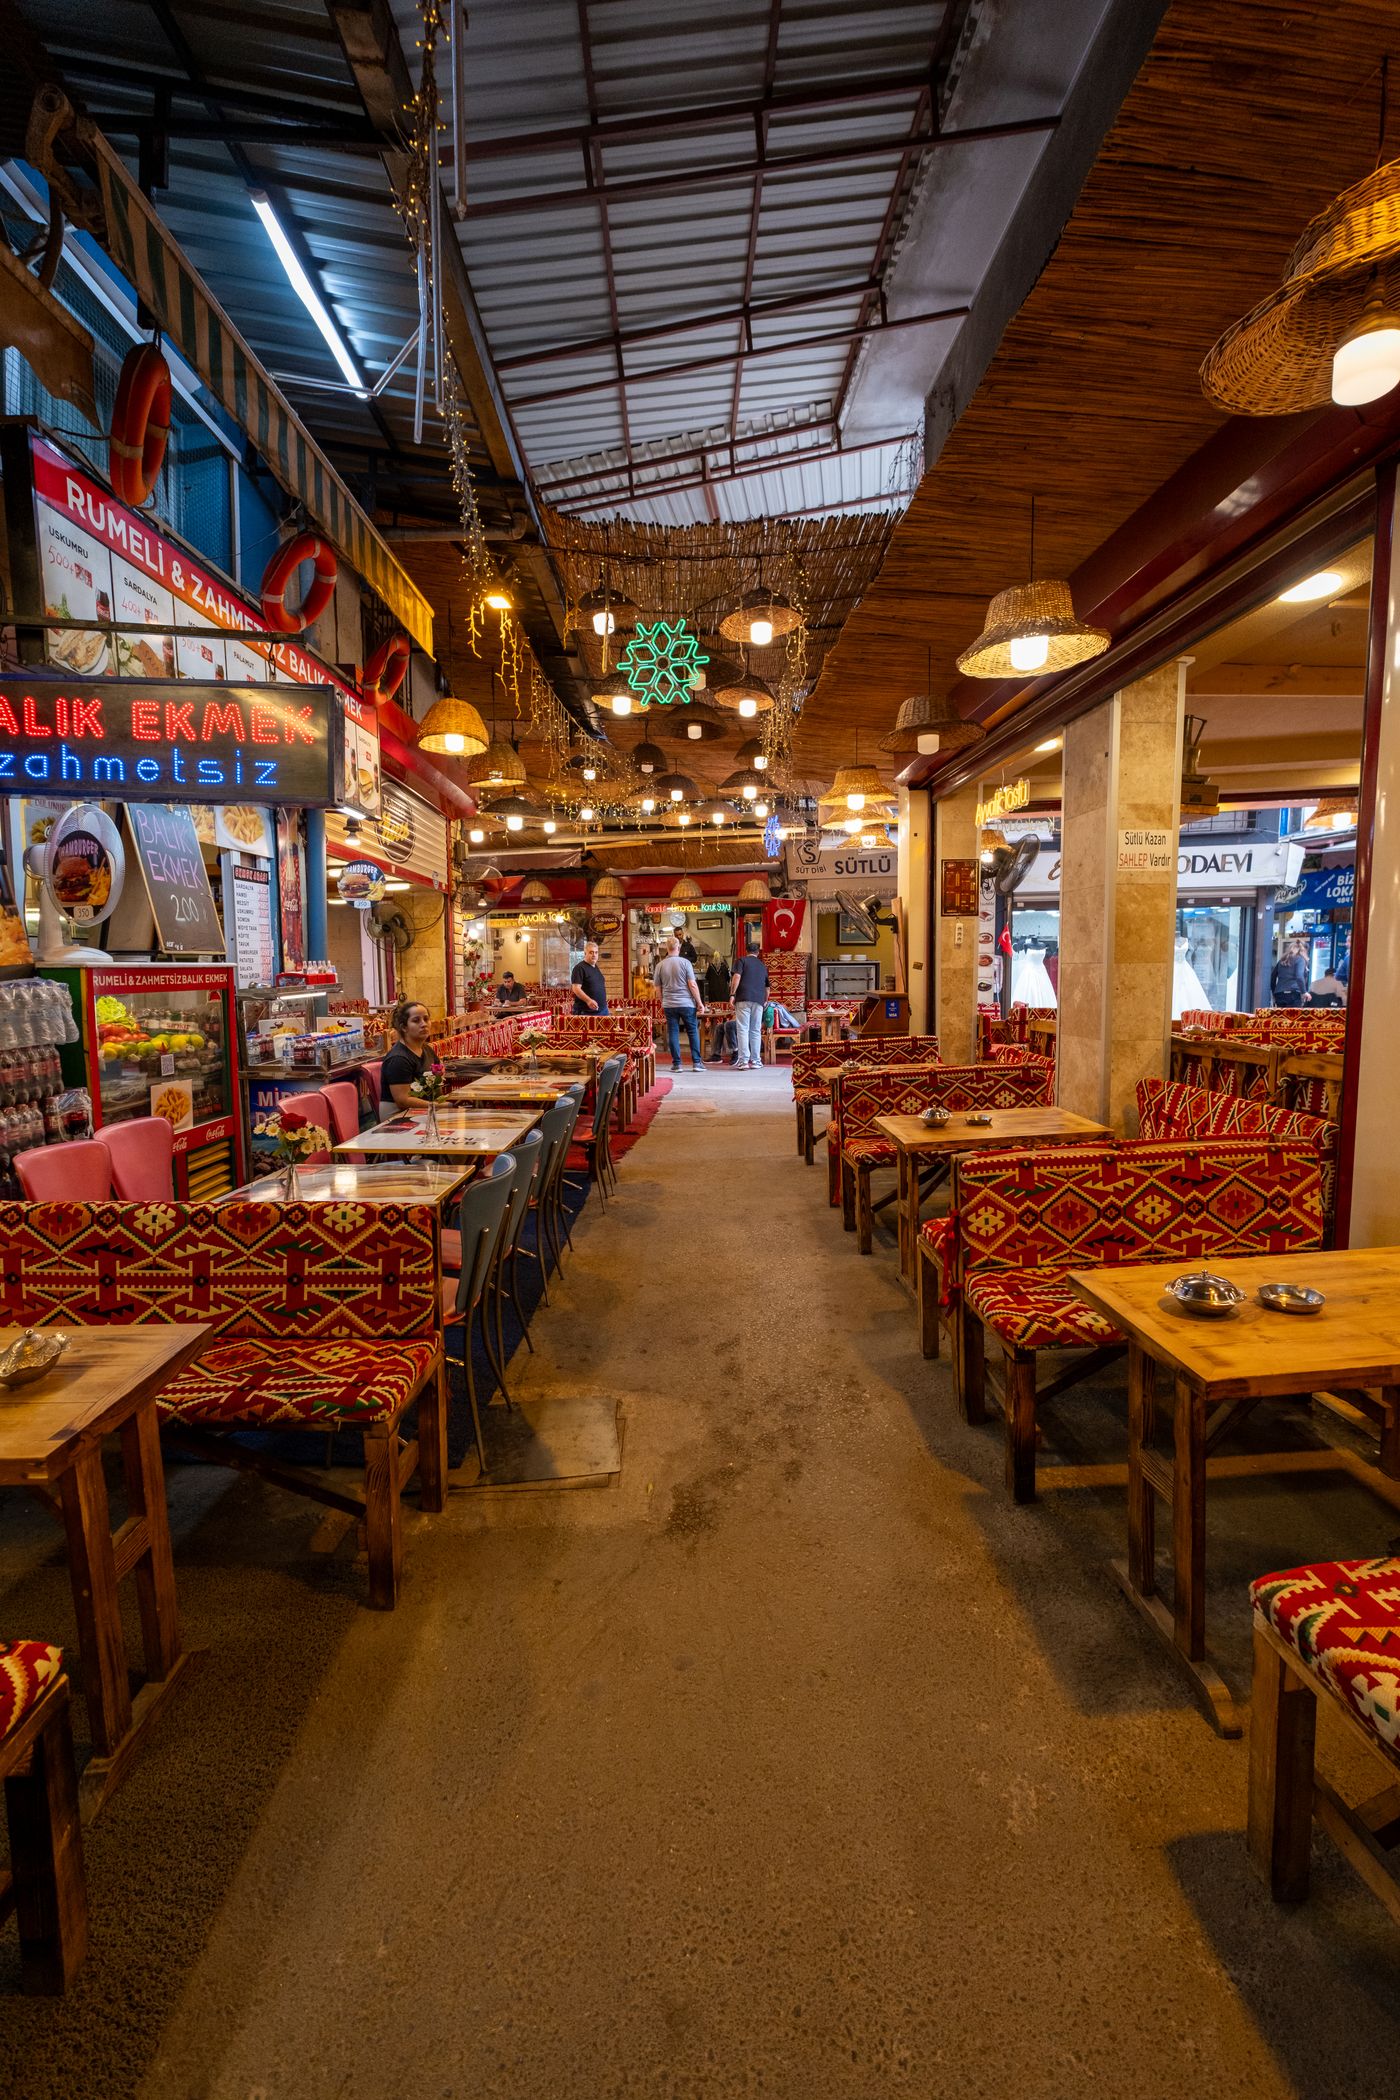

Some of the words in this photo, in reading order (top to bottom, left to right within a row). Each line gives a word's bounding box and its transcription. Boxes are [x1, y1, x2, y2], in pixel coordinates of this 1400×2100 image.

[48, 526, 89, 560] USKUMRU
[66, 476, 164, 577] RUMELİ
[171, 560, 186, 591] &
[123, 577, 158, 606] SARDALYA
[131, 699, 315, 745] EKMEK
[0, 742, 279, 786] zahmetsiz
[136, 808, 194, 855] BALIK
[1124, 831, 1143, 846] Sütlü
[1144, 833, 1167, 846] Kazan
[146, 850, 203, 889] EKMEK
[795, 865, 810, 874] SÜT
[811, 864, 827, 874] DİBİ
[834, 855, 891, 875] SÜTLÜ
[1118, 854, 1148, 867] SAHLEP
[1149, 854, 1171, 867] Vardır
[77, 908, 90, 919] 350
[170, 894, 200, 923] 200
[93, 973, 128, 987] RUMELİ
[135, 973, 182, 986] ZAHMETSİZ
[182, 974, 204, 985] BALIK
[205, 973, 228, 984] EKMEK
